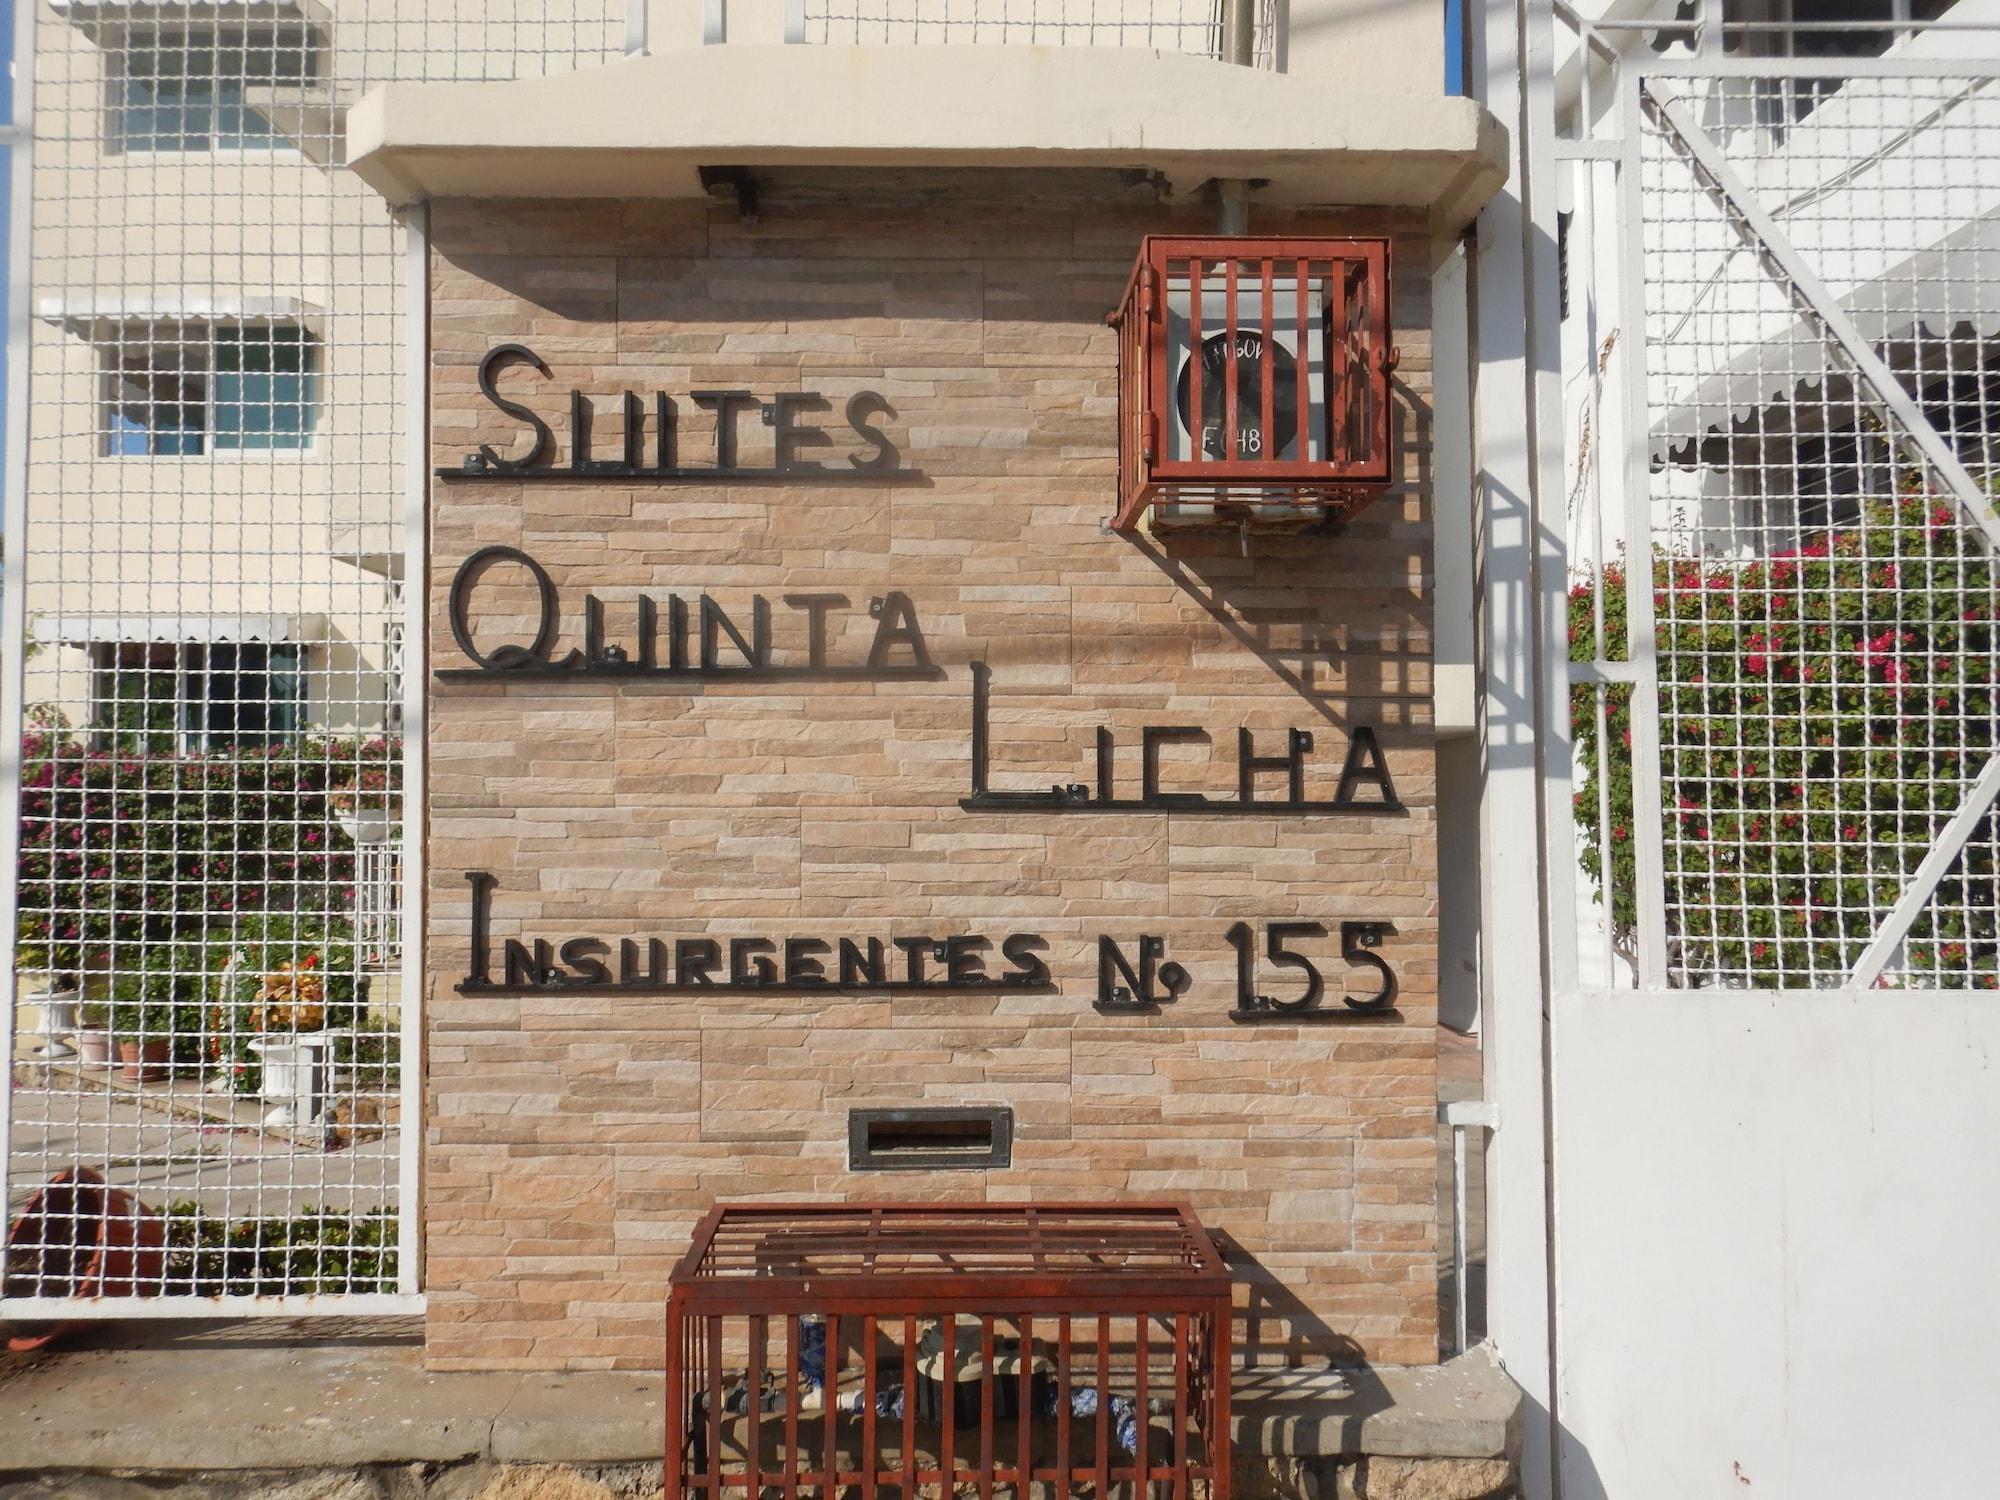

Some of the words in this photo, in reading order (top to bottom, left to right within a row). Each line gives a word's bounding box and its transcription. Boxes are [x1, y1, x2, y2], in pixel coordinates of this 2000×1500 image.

[478, 342, 898, 472] SUITES
[448, 543, 935, 672] QUINTA
[968, 660, 1396, 804] LICHA
[463, 871, 1050, 986] INSURGENTES
[1224, 921, 1395, 1011] 155
